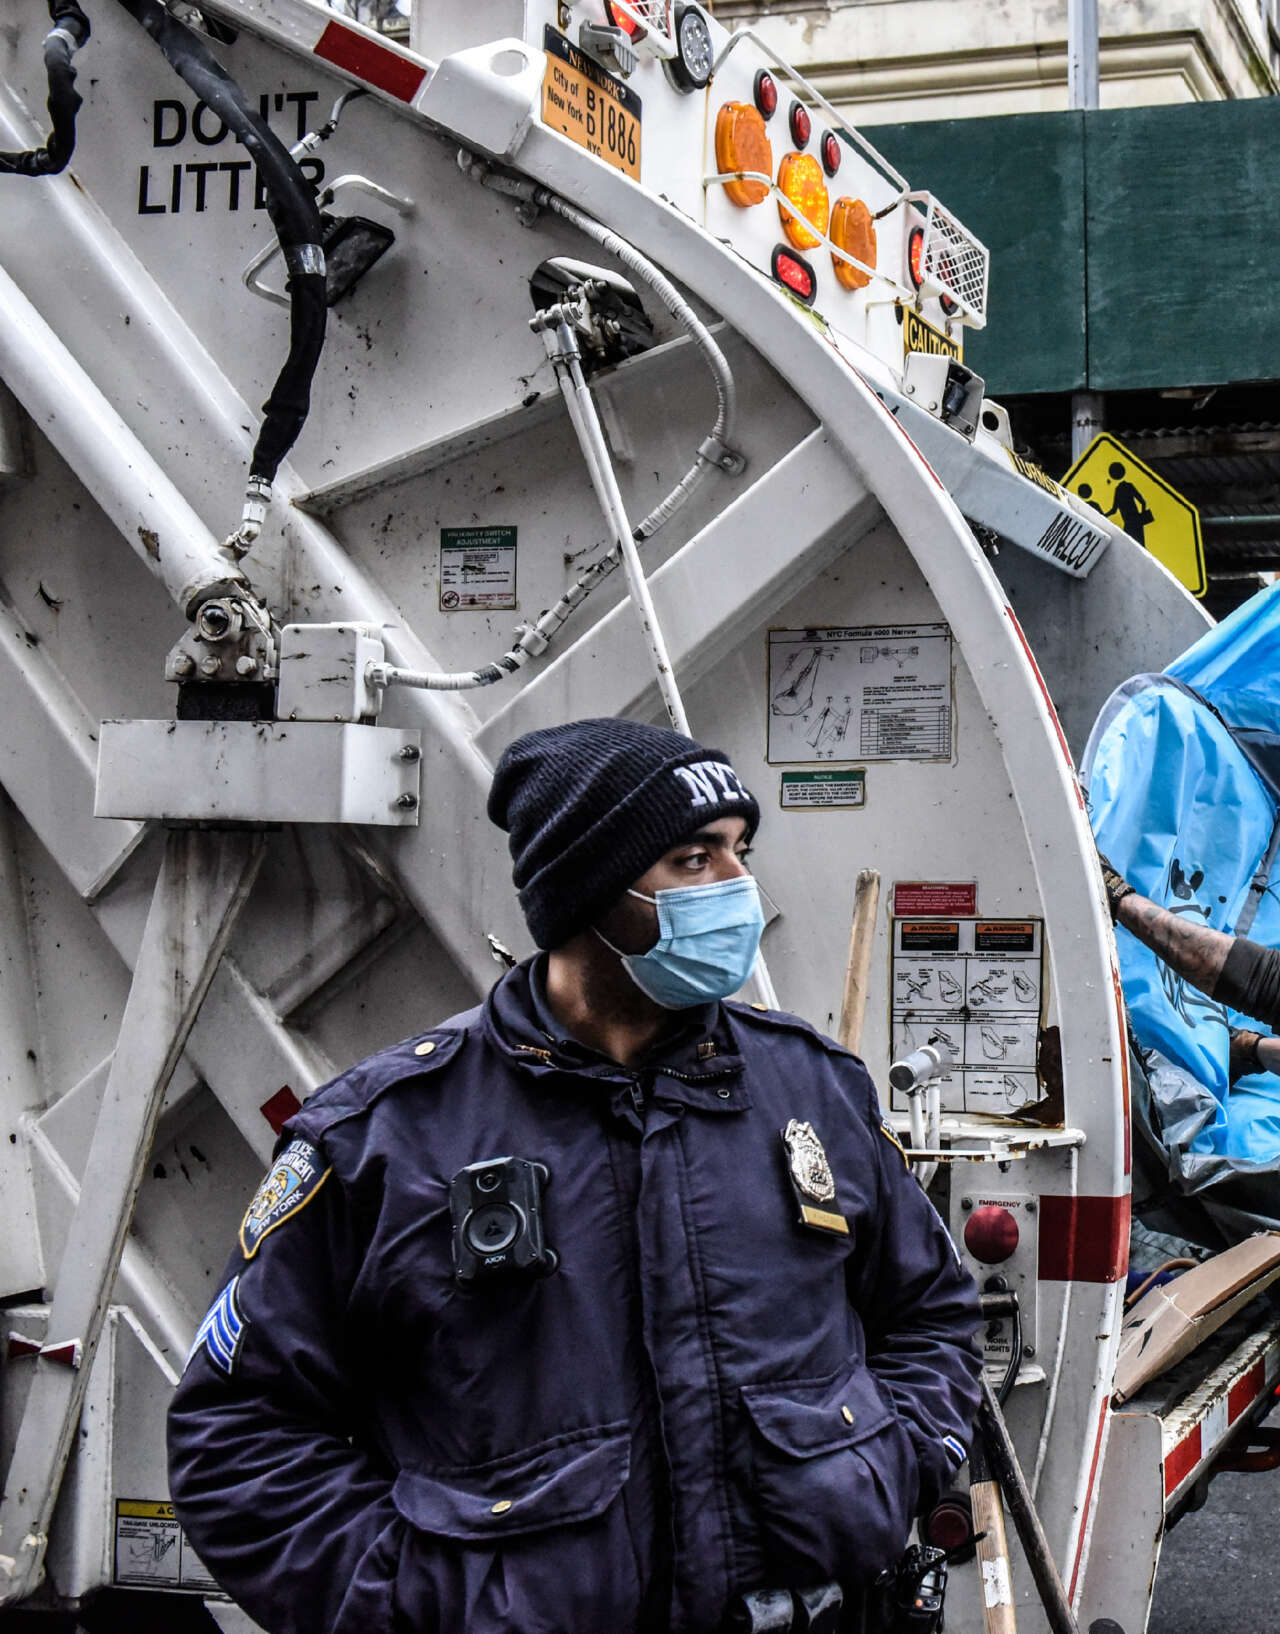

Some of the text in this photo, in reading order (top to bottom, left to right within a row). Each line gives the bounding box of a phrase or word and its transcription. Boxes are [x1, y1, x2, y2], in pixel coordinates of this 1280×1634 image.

[553, 67, 579, 97] City of
[547, 86, 584, 125] New York
[586, 139, 602, 158] NYC
[891, 628, 917, 636] Narrow
[288, 1140, 316, 1160] OLICE
[272, 1190, 304, 1217] YORK
[978, 1199, 1020, 1208] EMERGENCY
[485, 1255, 506, 1264] AXON
[984, 1345, 1010, 1353] LIGHTS
